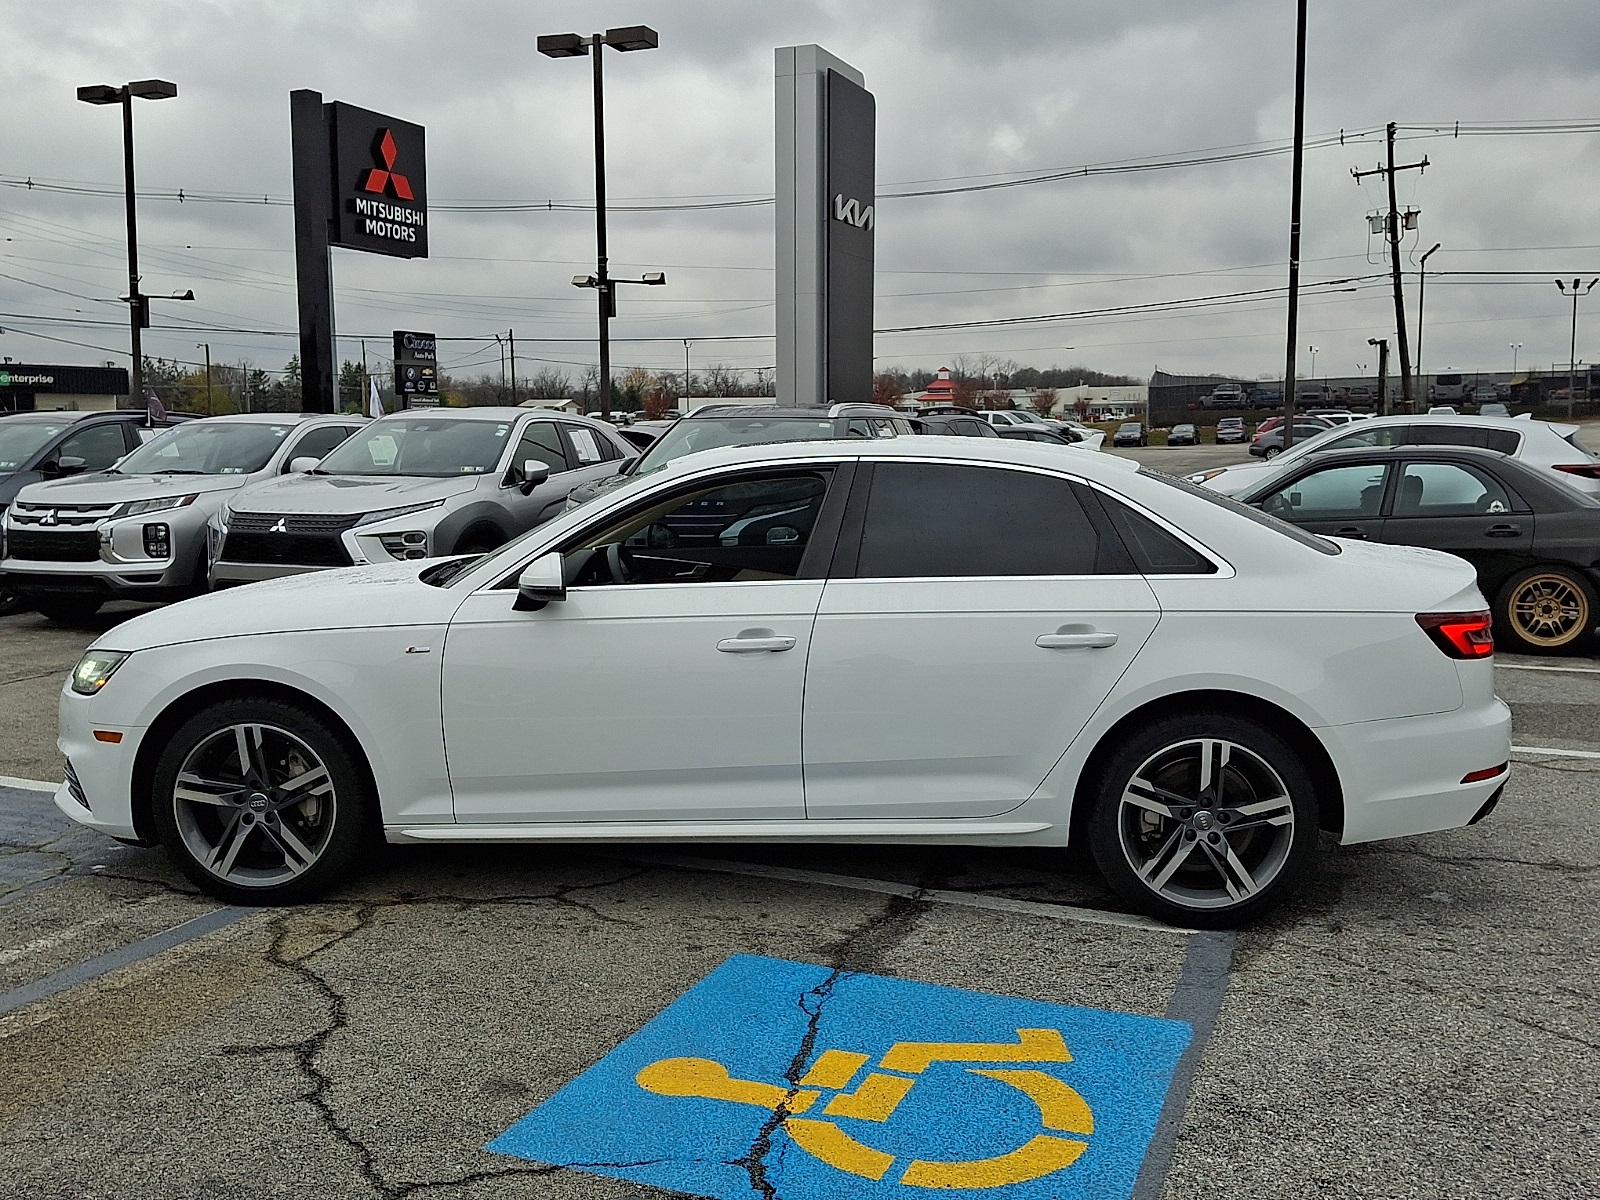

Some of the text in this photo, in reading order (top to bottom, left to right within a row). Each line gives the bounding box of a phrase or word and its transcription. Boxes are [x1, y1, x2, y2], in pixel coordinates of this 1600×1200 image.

[356, 198, 424, 226] MITSUBISHI
[366, 219, 416, 242] MOTORS
[425, 352, 434, 360] Park
[0, 374, 54, 385] enterprise
